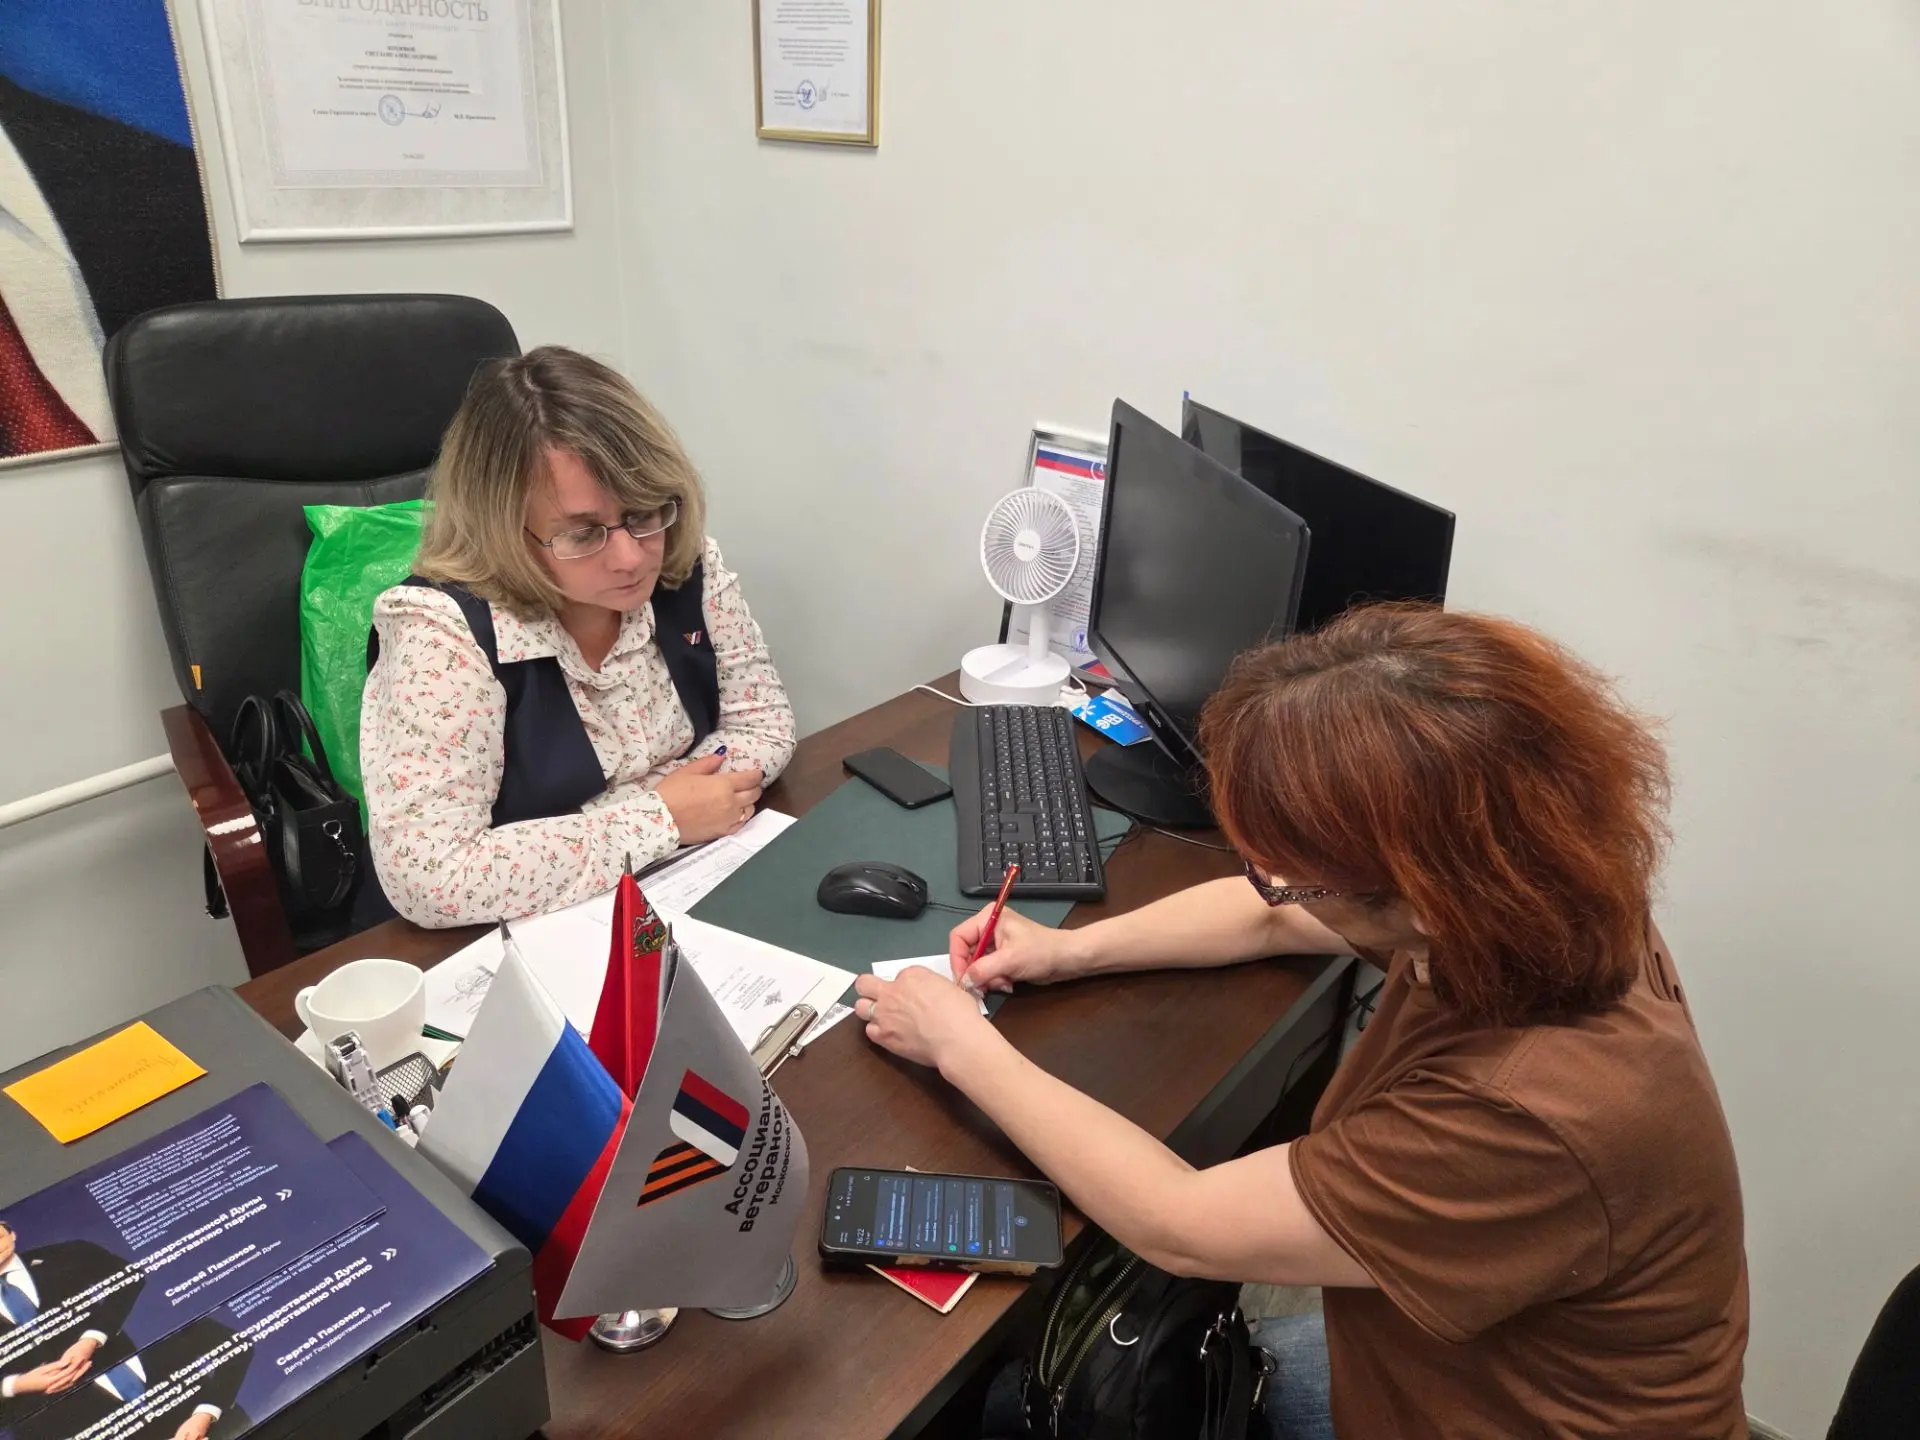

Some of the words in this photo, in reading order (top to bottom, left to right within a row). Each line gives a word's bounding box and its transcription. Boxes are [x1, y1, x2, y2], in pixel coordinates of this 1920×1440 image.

[724, 1079, 774, 1215] Ассоциаци
[739, 1105, 783, 1233] ветеранов
[769, 1126, 791, 1205] Московской
[60, 1268, 126, 1308] Комитета
[124, 1213, 230, 1274] Государственной
[228, 1195, 264, 1219] Думы
[75, 1271, 146, 1314] хозяйству,
[145, 1226, 226, 1277] представляю
[225, 1202, 270, 1232] партию
[163, 1269, 208, 1298] Сергей
[207, 1243, 258, 1275] Пахомов
[170, 1284, 202, 1306] Депутат
[201, 1251, 262, 1289] Государственной
[261, 1239, 283, 1255] Думы
[34, 1309, 92, 1347] Россия»
[167, 1338, 232, 1381] Комитета
[231, 1277, 334, 1343] Государственной
[333, 1257, 368, 1282] Думы
[183, 1340, 254, 1388] хозяйству,
[252, 1292, 332, 1346] представляю
[330, 1264, 375, 1297] партию
[275, 1336, 319, 1368] Сергей
[317, 1306, 367, 1341] Пахомов
[283, 1352, 314, 1376] Депутат
[313, 1313, 373, 1356] Государственной
[372, 1300, 393, 1317] Думы
[144, 1384, 203, 1423] Россия»
